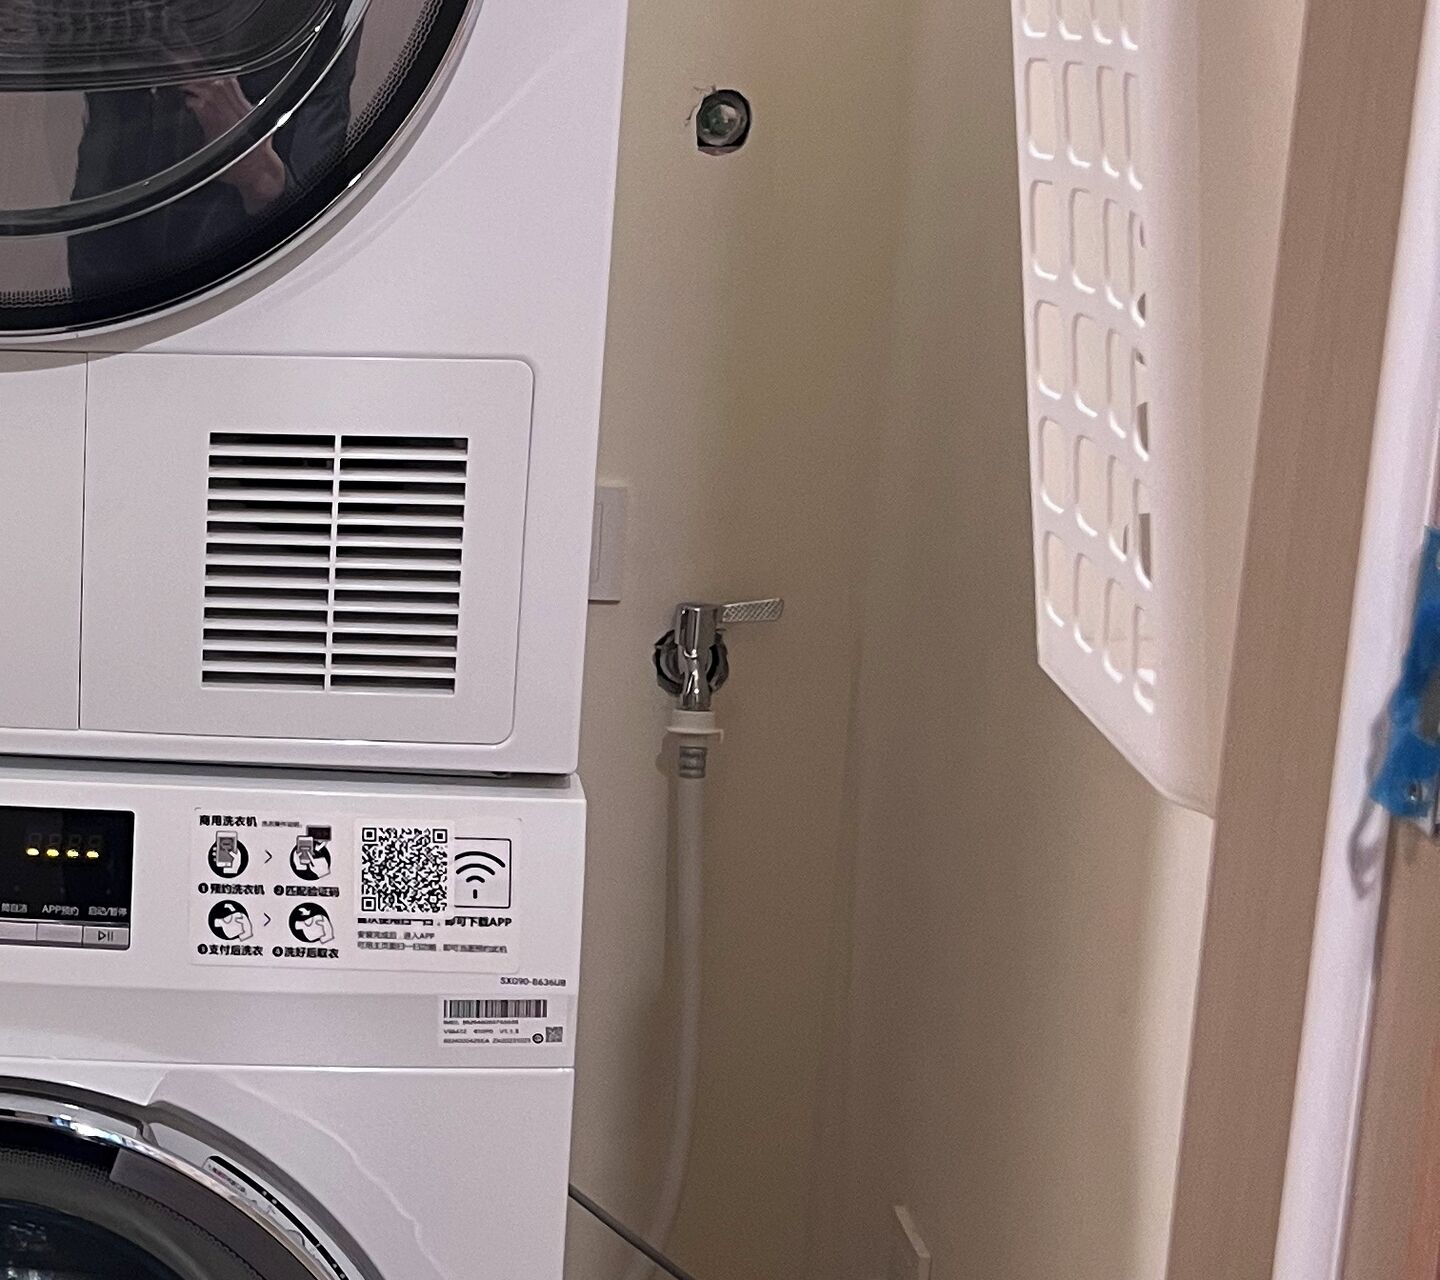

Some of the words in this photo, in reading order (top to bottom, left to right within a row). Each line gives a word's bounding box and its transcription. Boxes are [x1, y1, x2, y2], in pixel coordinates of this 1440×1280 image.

[199, 815, 257, 828] 商用洗衣机
[210, 883, 265, 895] 预约洗衣机
[209, 944, 264, 956] 支付后洗衣
[284, 947, 339, 959] 洗好后取衣
